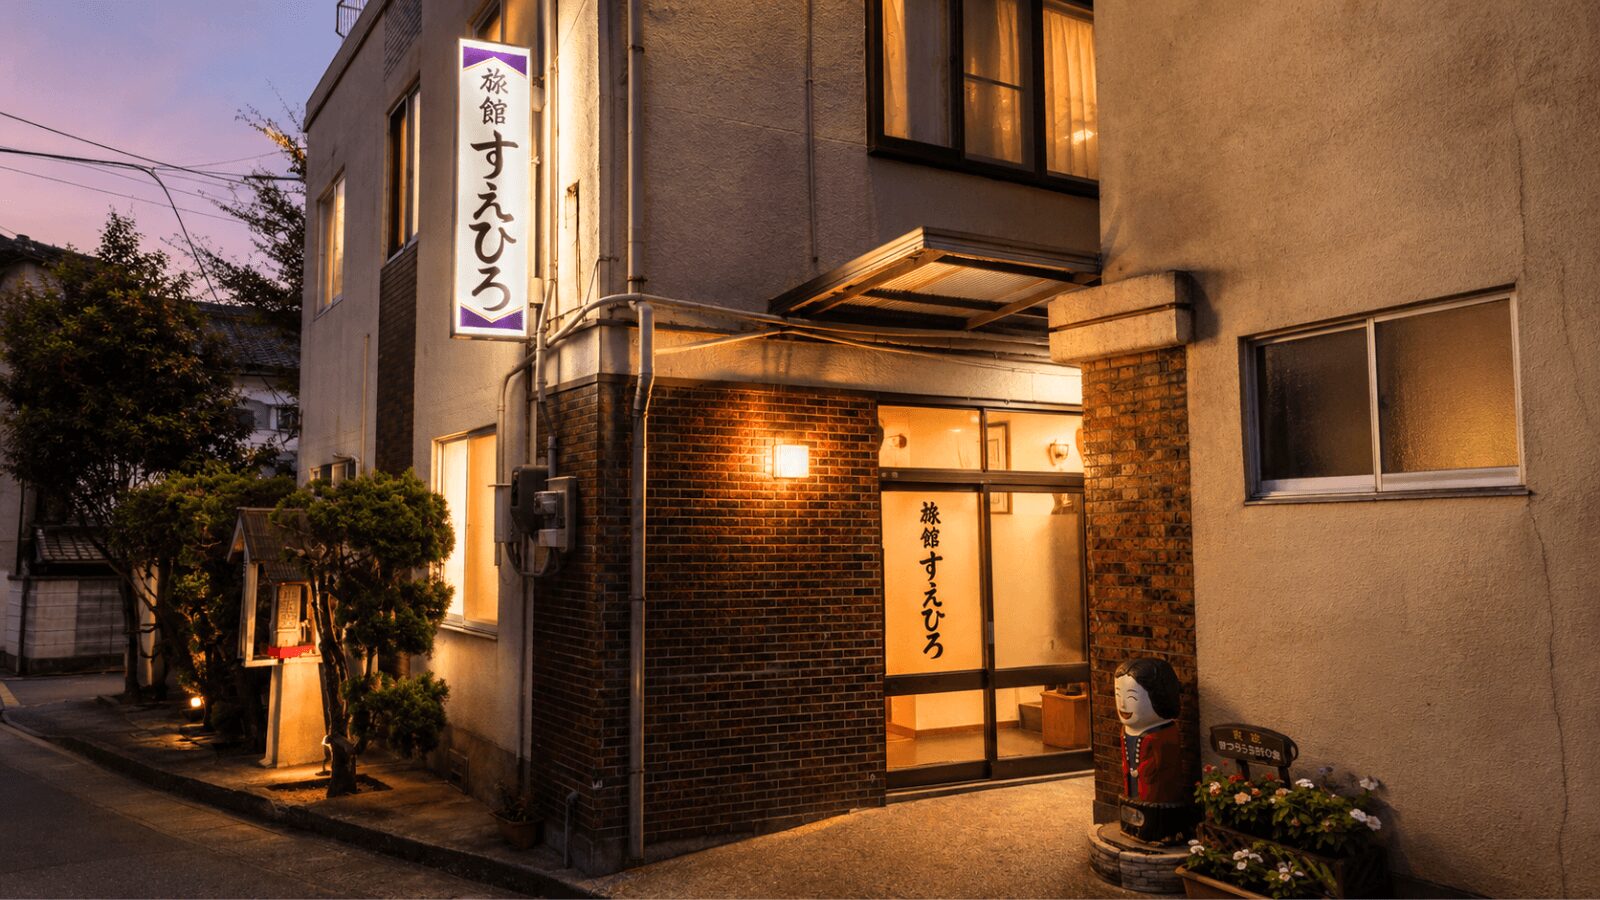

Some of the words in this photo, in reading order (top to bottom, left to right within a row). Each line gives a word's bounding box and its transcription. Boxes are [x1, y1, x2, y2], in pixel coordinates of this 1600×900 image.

[469, 67, 519, 311] 旅館すえひろ
[919, 501, 945, 660] 旅館すえひろ
